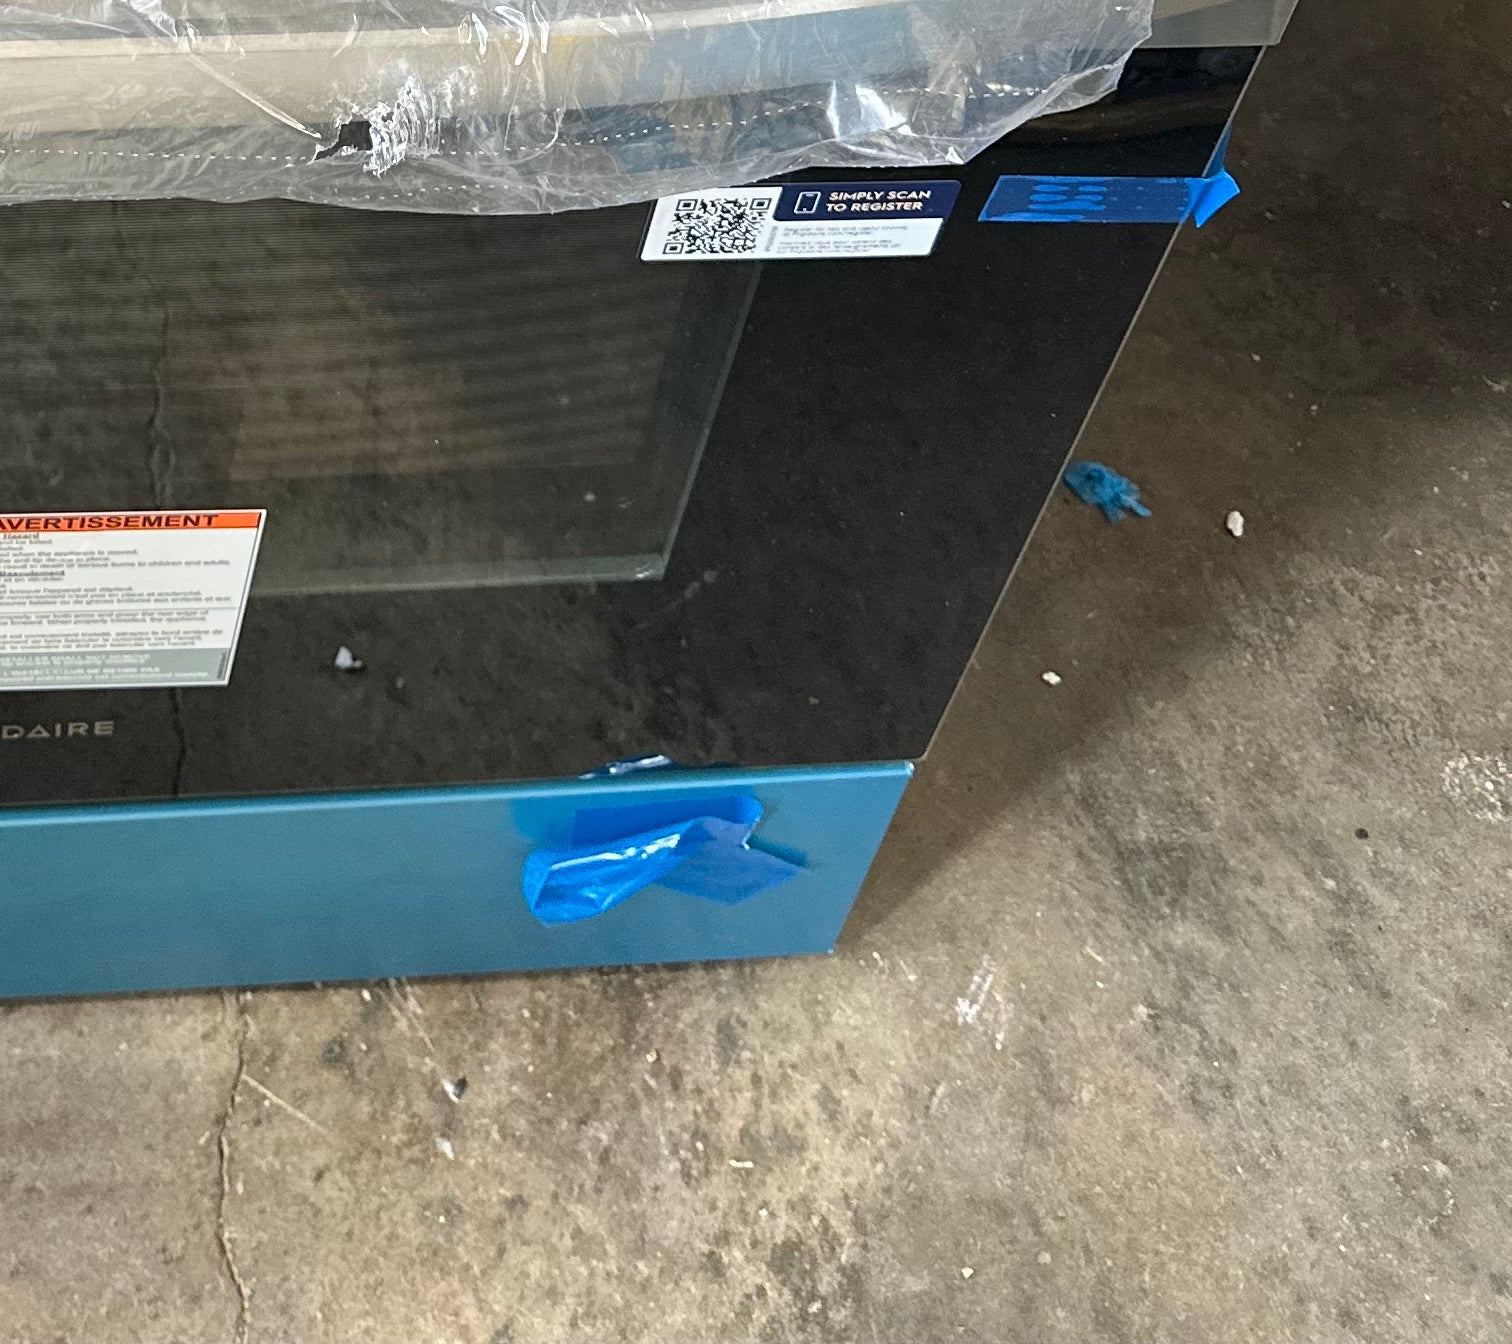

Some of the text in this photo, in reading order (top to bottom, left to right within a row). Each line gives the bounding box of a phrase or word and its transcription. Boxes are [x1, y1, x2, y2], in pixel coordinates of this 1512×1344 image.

[829, 190, 931, 201] SIMPLY SCAN
[826, 202, 923, 212] TO REGISTER
